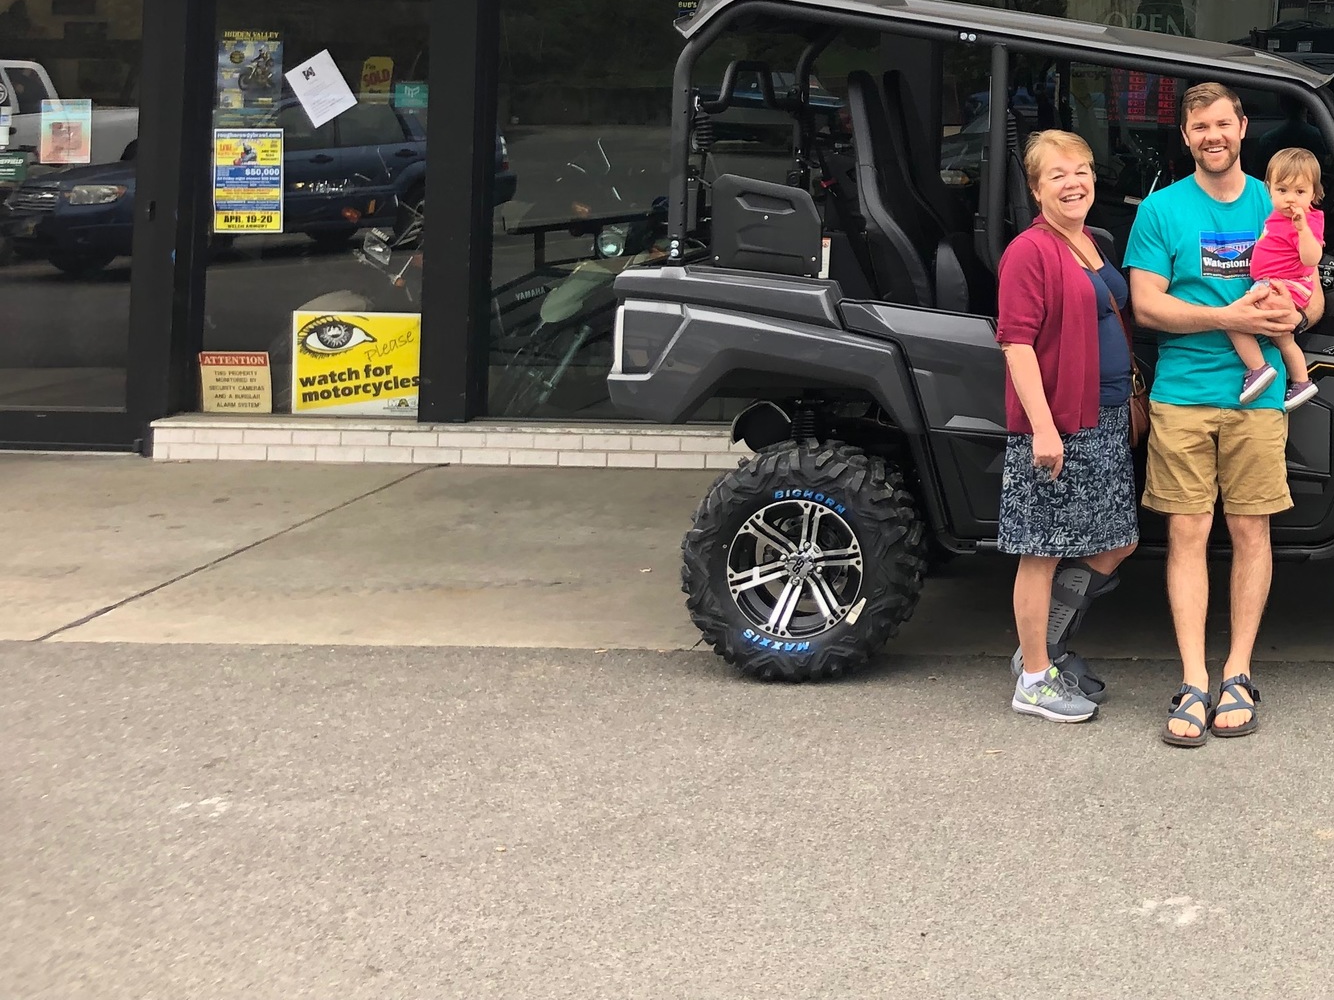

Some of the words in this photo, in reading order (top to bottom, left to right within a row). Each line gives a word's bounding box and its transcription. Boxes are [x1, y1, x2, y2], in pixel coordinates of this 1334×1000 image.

[252, 31, 280, 39] VALLEY
[362, 69, 391, 87] SOLD
[245, 168, 280, 176] $50,000
[246, 215, 273, 223] 19-20
[515, 286, 546, 301] YAMAHA
[204, 355, 265, 365] ATTENTION
[299, 367, 361, 388] watch
[363, 364, 394, 379] for
[301, 375, 420, 403] motorcycles
[773, 489, 847, 515] BIGHORN
[742, 628, 810, 653] MAXXIS
